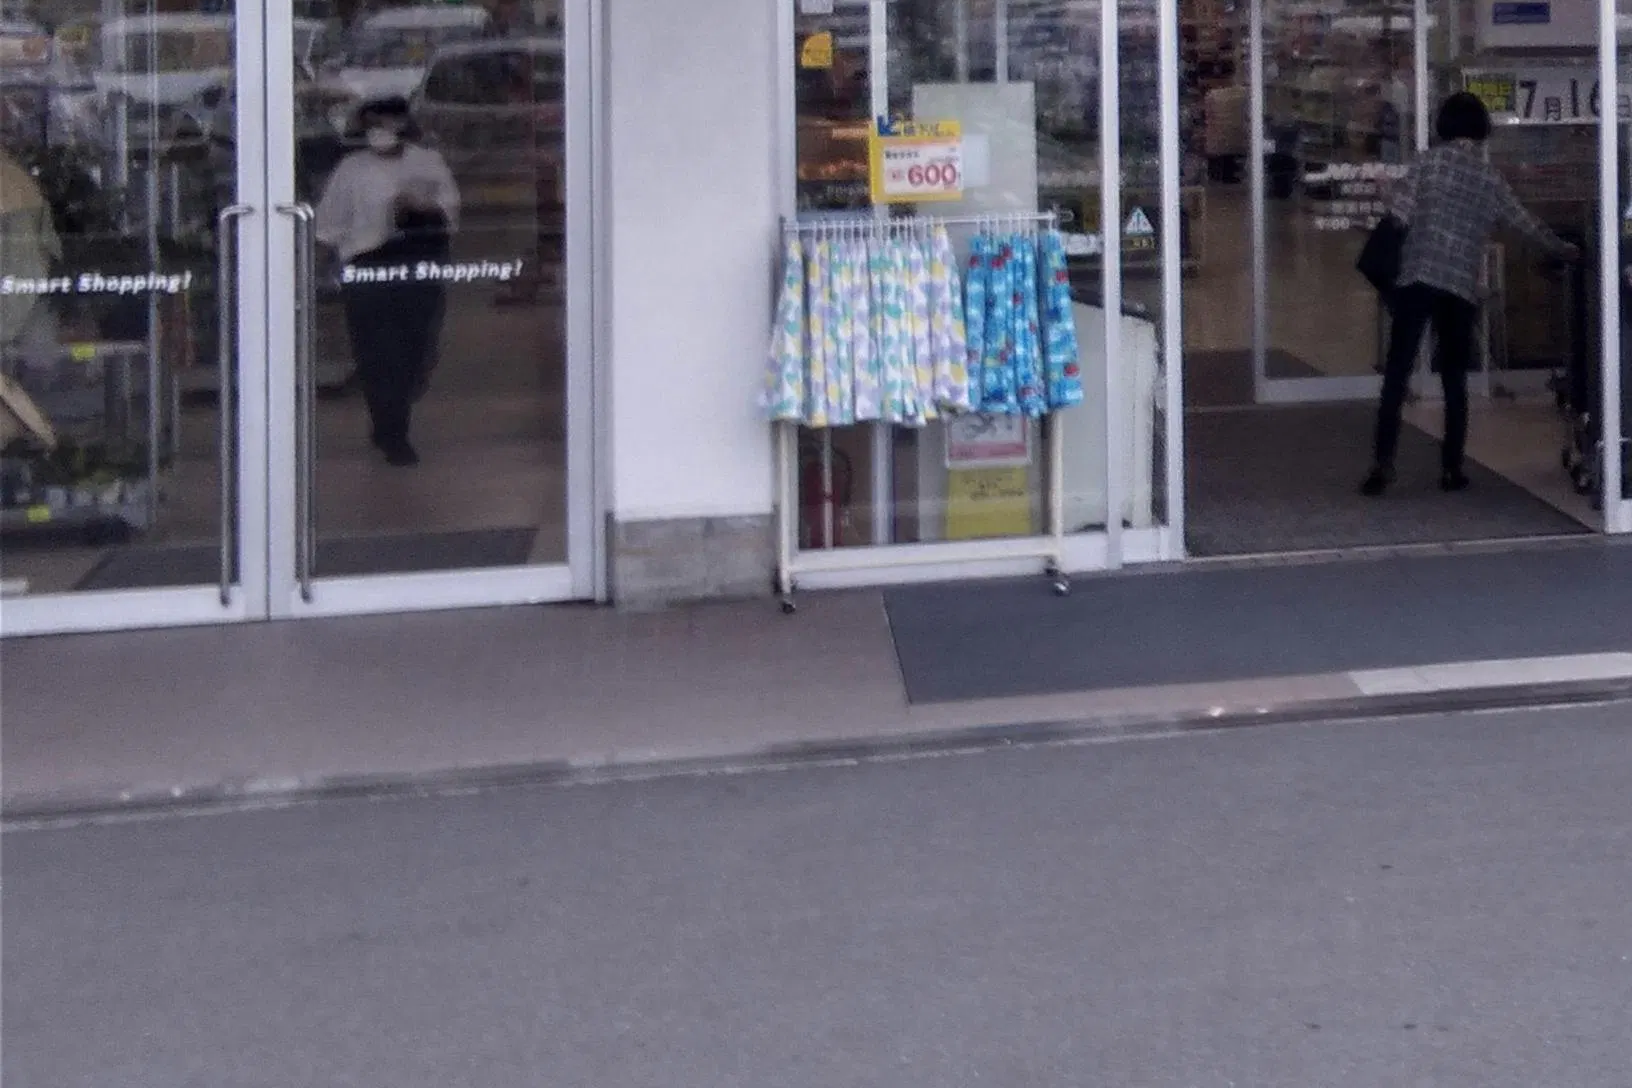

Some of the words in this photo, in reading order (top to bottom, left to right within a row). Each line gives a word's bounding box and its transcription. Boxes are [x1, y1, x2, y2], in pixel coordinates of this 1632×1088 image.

[908, 164, 957, 188] 600
[0, 275, 71, 295] Smart
[77, 269, 193, 295] Shopping!
[342, 264, 409, 283] Smart
[415, 258, 524, 283] Shopping!
